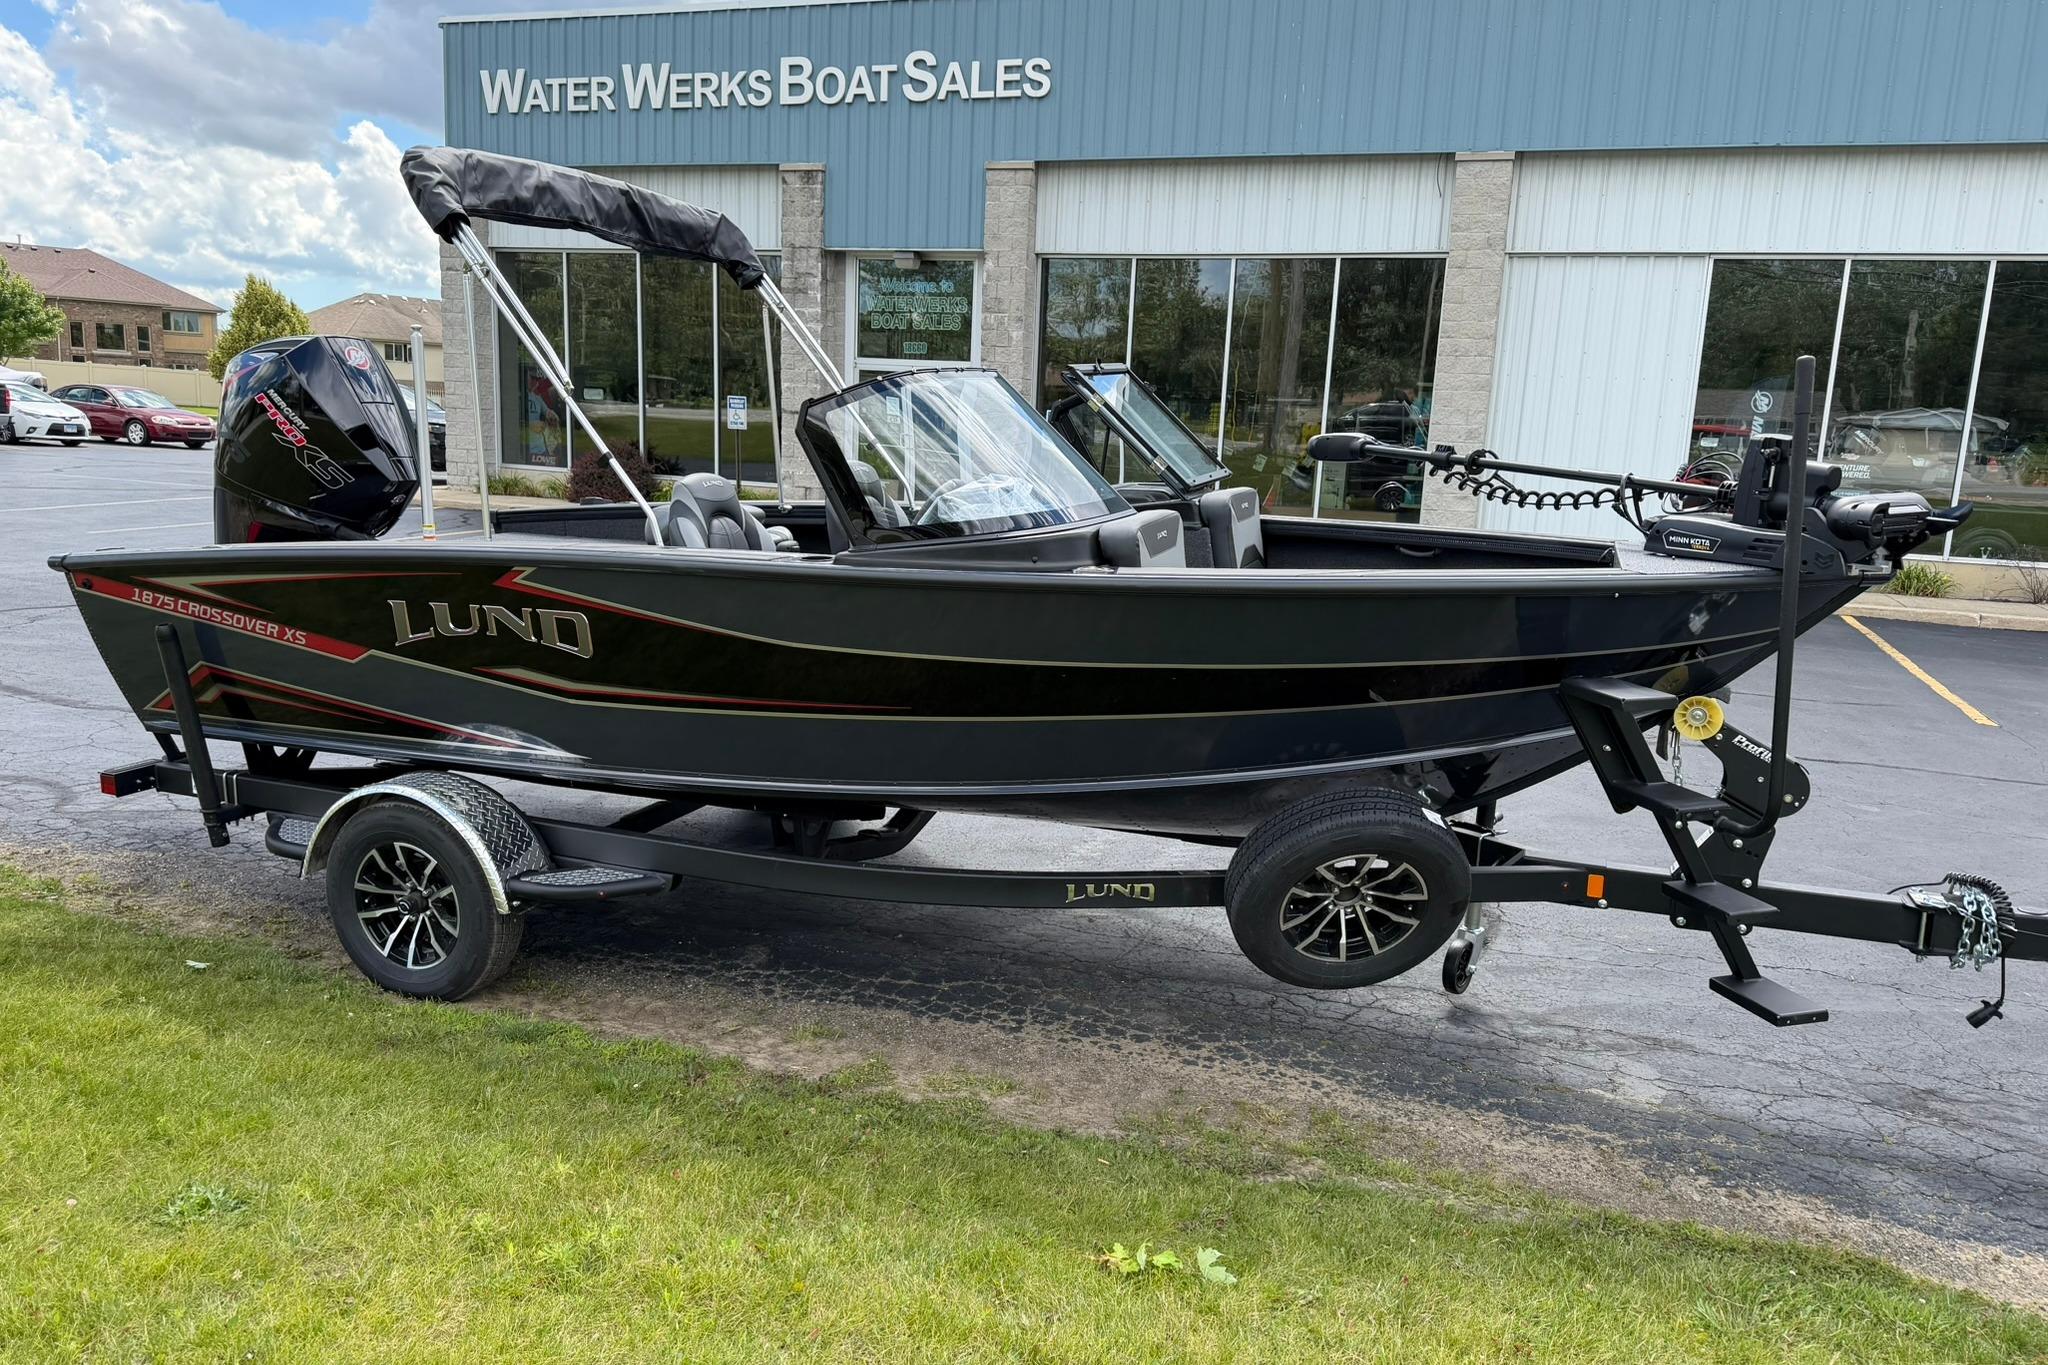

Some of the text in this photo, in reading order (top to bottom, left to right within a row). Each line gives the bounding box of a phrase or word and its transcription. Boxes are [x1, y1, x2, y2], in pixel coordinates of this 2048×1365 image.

[480, 50, 1052, 114] WATER WERKS BOAT SALES
[880, 277, 955, 294] Welcome to
[871, 312, 961, 331] BOAT SALES
[254, 393, 307, 447] PRO
[266, 388, 310, 432] MERCURY
[1854, 430, 1885, 456] MERCURY
[272, 432, 355, 489] XS
[1841, 464, 1870, 472] ENTURE,
[1842, 471, 1870, 479] WERED.
[1669, 535, 1711, 546] MINN KOTA
[131, 588, 307, 645] 1875 CROSSOVER XS
[387, 600, 593, 659] LUND
[1065, 883, 1155, 903] LUND
